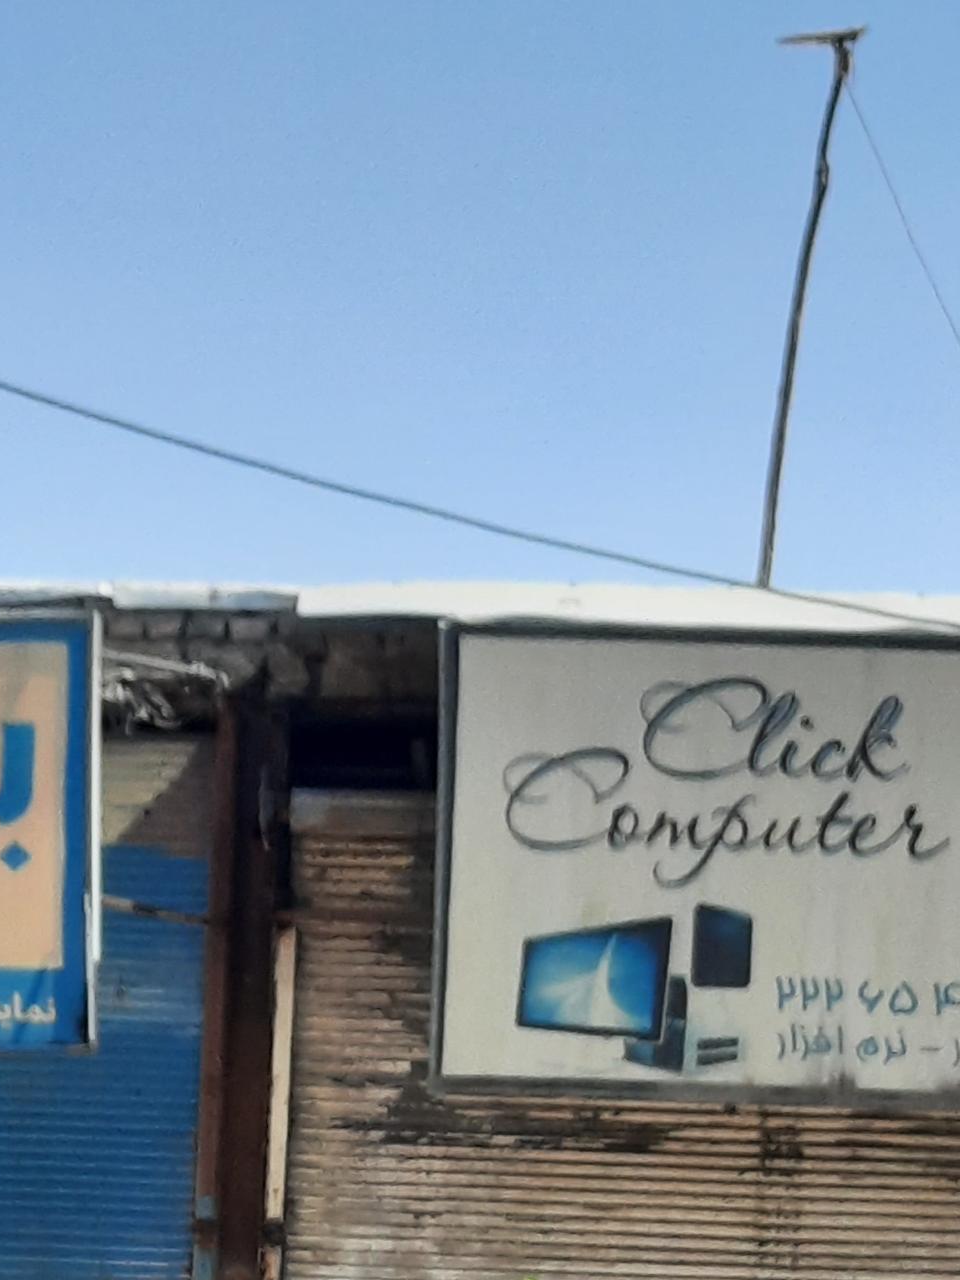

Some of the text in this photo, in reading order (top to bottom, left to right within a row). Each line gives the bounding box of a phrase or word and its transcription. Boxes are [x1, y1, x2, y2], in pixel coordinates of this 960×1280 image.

[640, 676, 911, 782] Click
[503, 746, 952, 889] Computer
[777, 1022, 844, 1062] افزار
[855, 1028, 908, 1066] نرم
